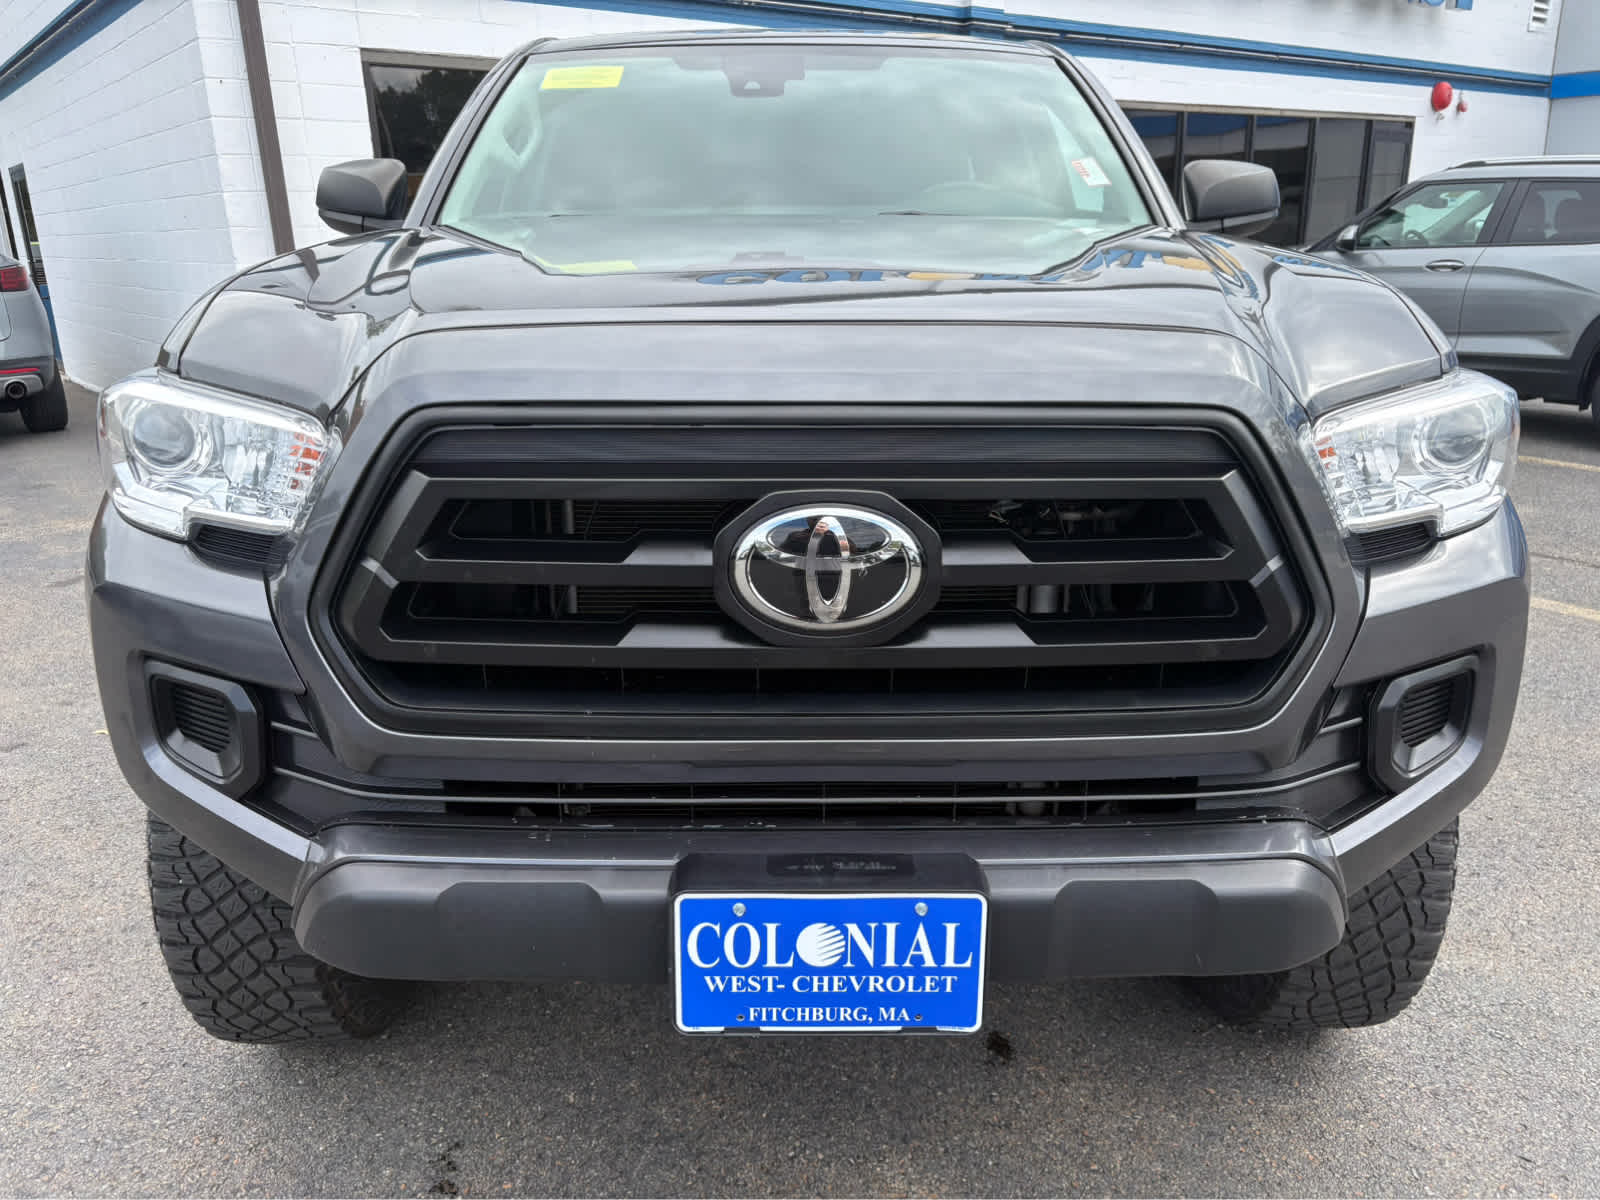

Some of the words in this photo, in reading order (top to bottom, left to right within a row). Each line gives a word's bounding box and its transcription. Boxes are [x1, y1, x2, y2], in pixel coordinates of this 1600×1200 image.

[704, 975, 785, 993] WEST-
[792, 975, 958, 993] CHEVROLET
[749, 1007, 873, 1023] FITCHBURG,
[878, 1007, 910, 1022] MA
